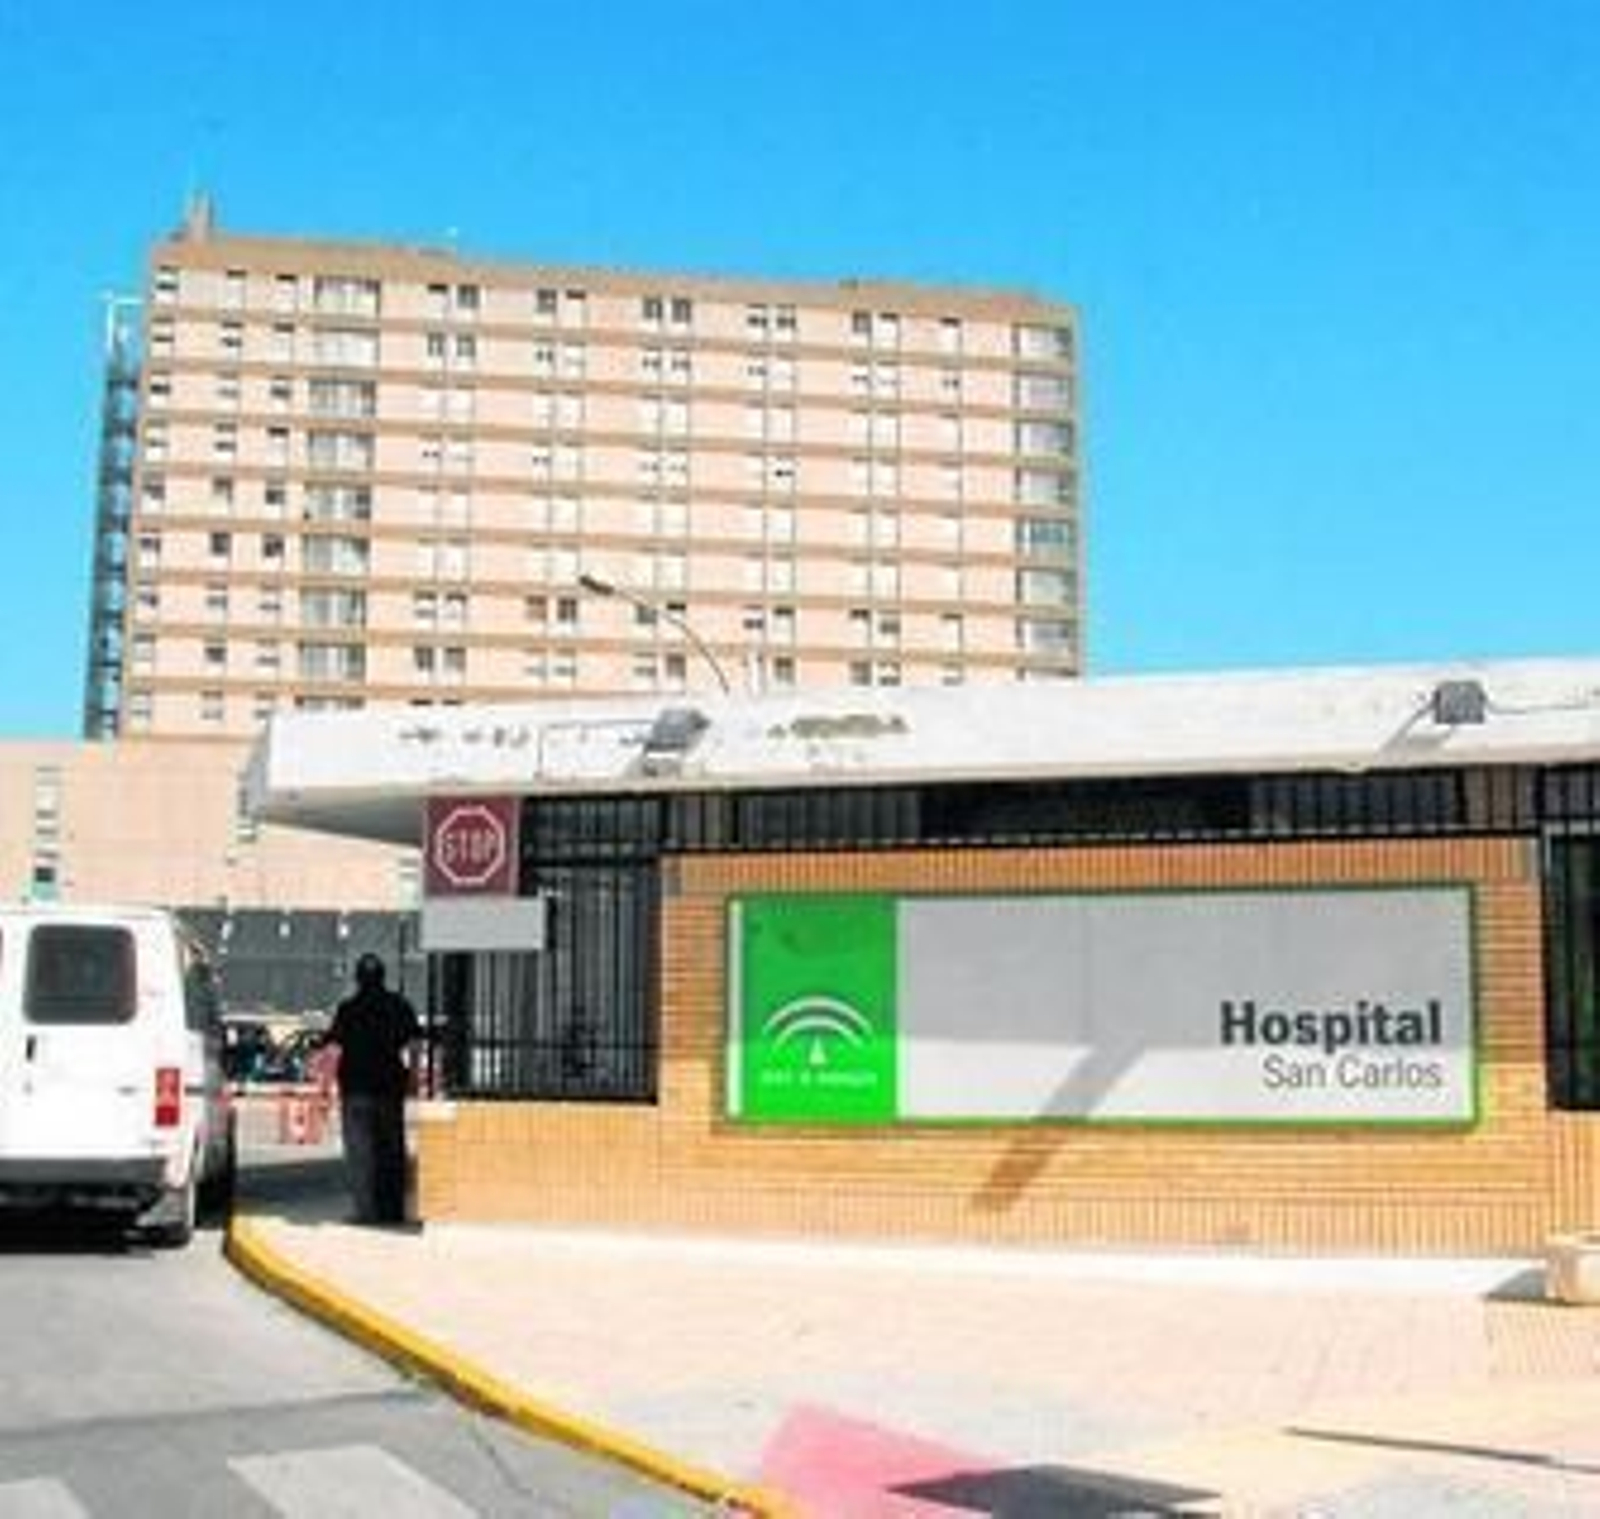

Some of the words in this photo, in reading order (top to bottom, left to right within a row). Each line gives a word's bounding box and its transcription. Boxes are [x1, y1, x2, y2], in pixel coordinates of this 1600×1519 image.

[445, 829, 498, 864] STOP
[1220, 1000, 1442, 1054] Hospital
[1263, 1054, 1327, 1088] San
[1337, 1054, 1442, 1088] Carlos
